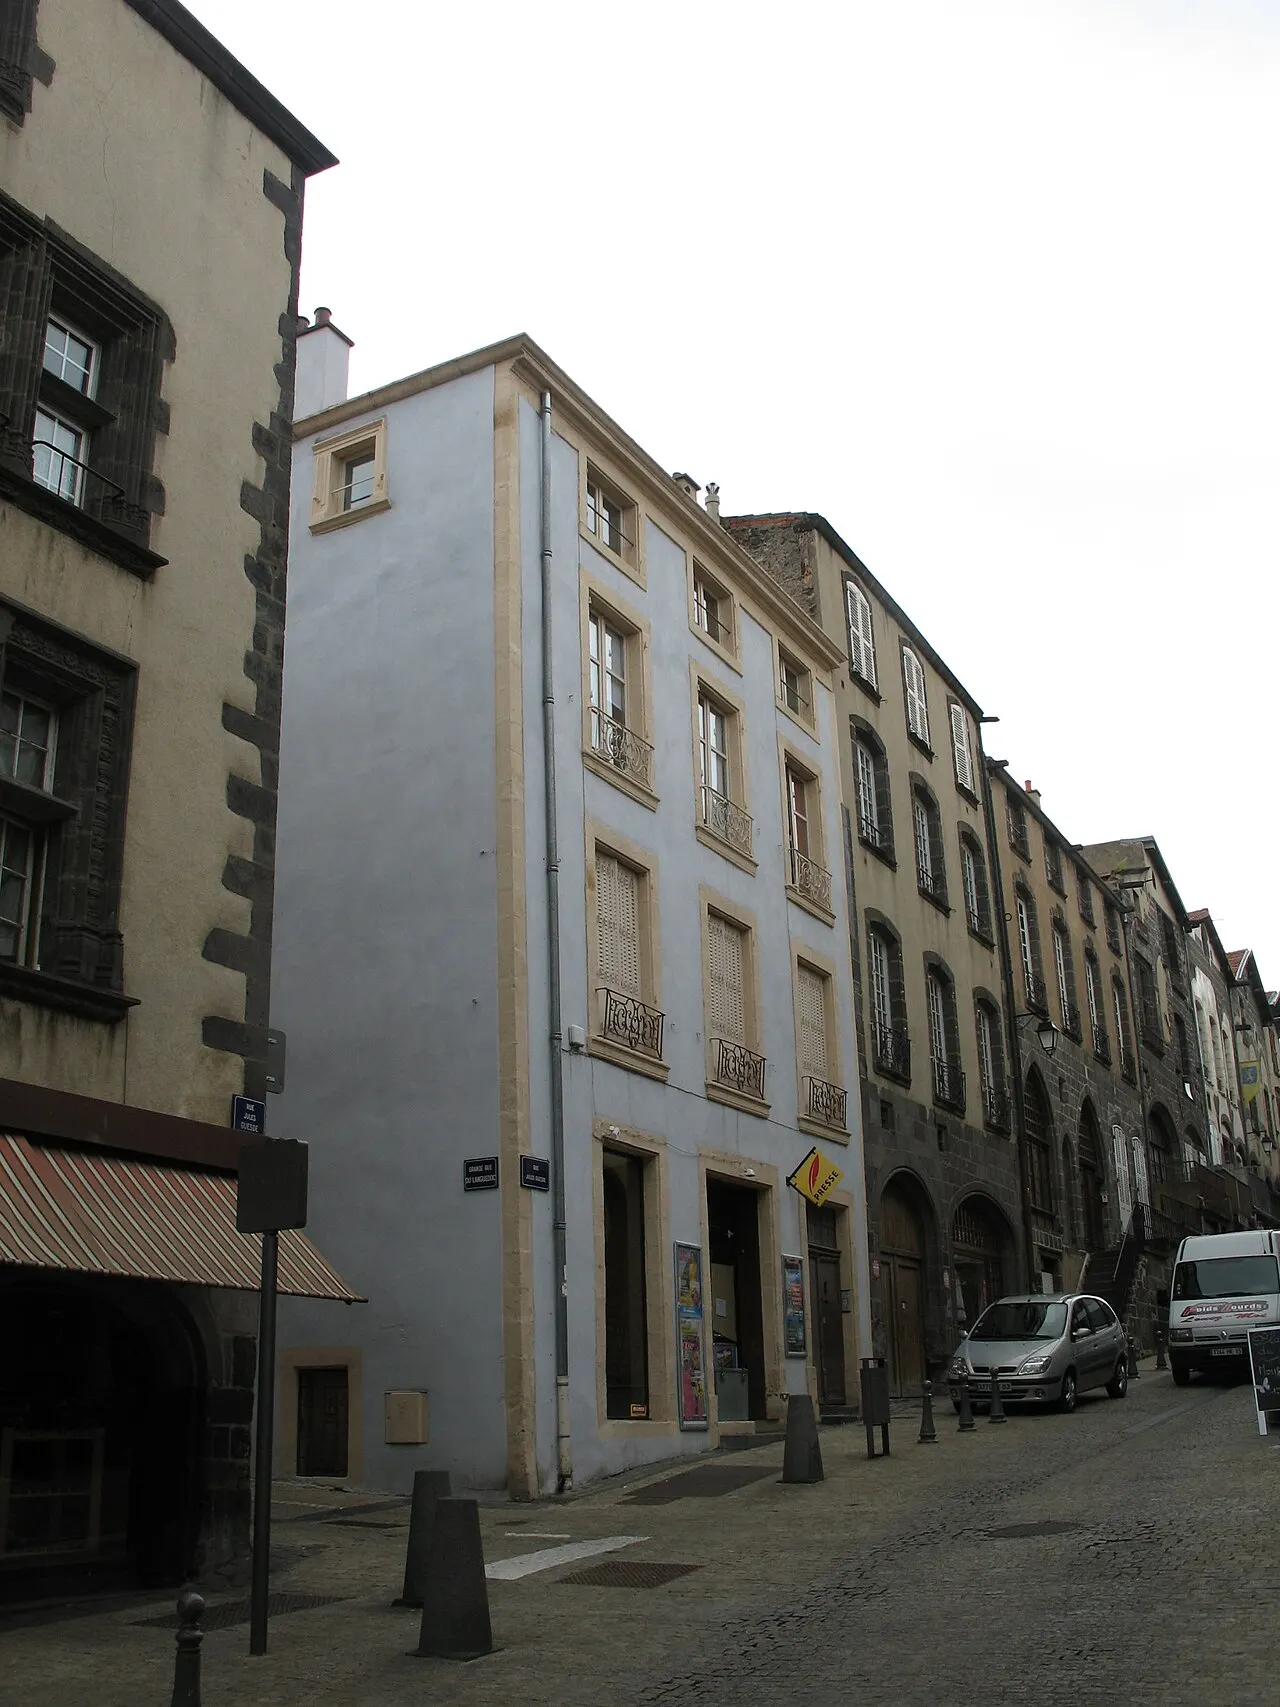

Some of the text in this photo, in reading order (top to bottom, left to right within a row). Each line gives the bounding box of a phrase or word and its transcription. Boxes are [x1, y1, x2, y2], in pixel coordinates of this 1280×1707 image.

[246, 1103, 255, 1111] RUE
[243, 1112, 256, 1121] JULES
[468, 1163, 493, 1173] GRANDE RUE
[472, 1174, 496, 1184] LANGUEDOC
[813, 1170, 839, 1200] PRESSE
[1182, 1305, 1218, 1316] Poids
